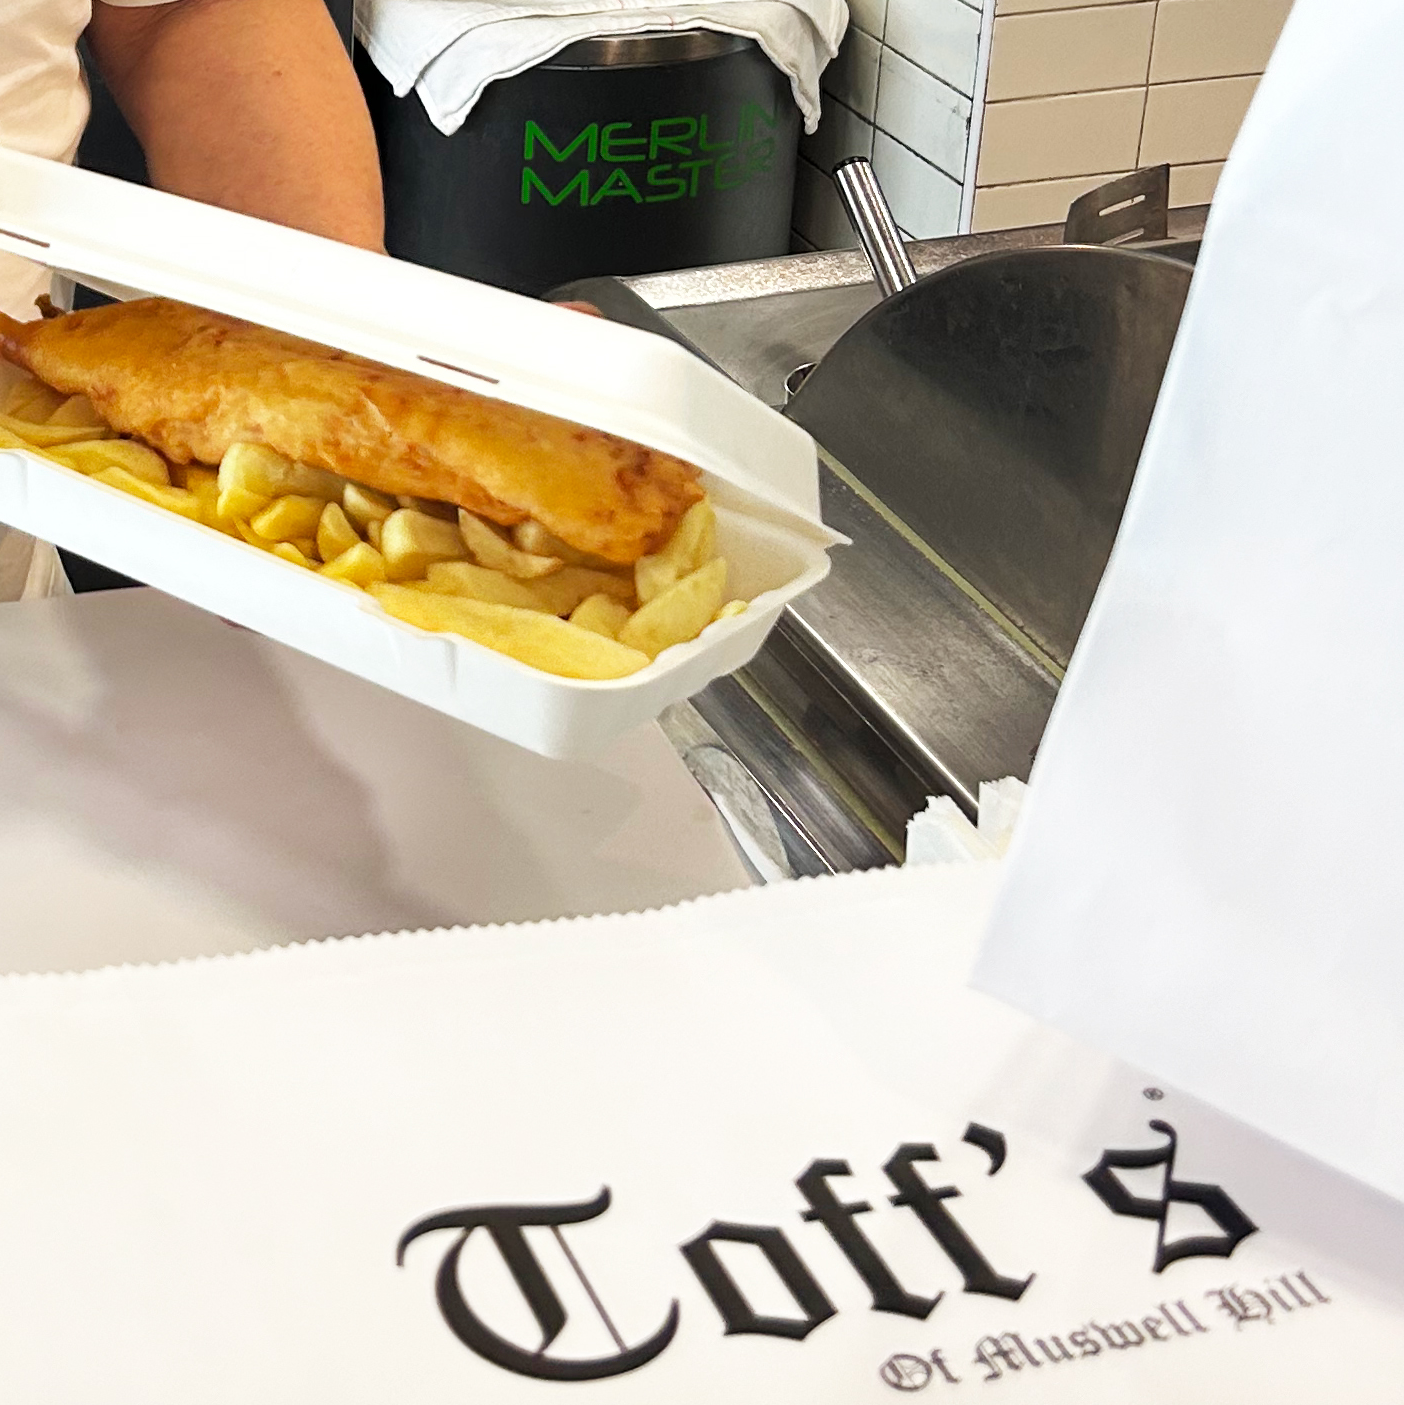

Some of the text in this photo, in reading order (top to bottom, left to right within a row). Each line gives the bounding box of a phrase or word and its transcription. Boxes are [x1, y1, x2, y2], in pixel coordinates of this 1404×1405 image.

[523, 99, 777, 163] MERLIN
[521, 137, 776, 207] MASTER
[879, 1269, 1332, 1393] Of Muswell Hill
